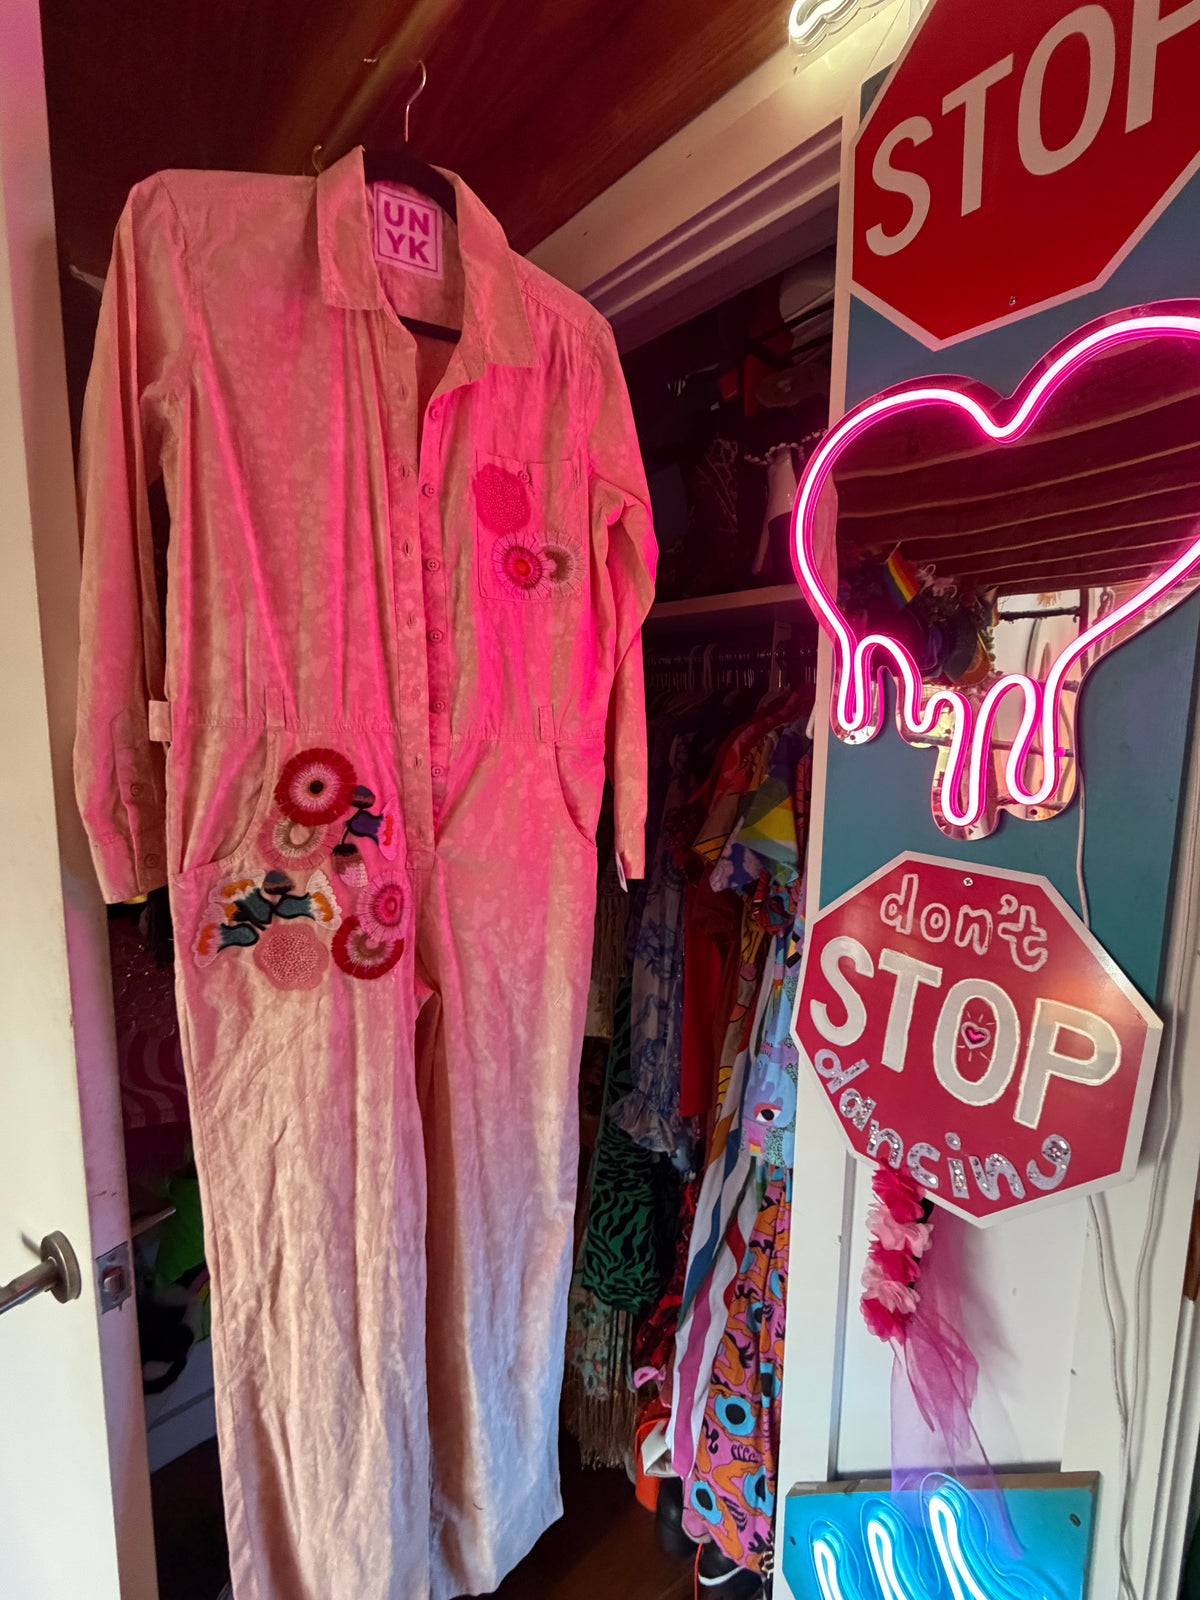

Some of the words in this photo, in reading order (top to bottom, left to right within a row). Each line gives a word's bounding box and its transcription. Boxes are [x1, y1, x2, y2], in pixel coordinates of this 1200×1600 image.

[384, 200, 429, 236] UN
[385, 228, 430, 263] YK
[880, 874, 1048, 972] don't
[810, 936, 1121, 1129] STOP
[814, 1049, 1072, 1200] dancing
